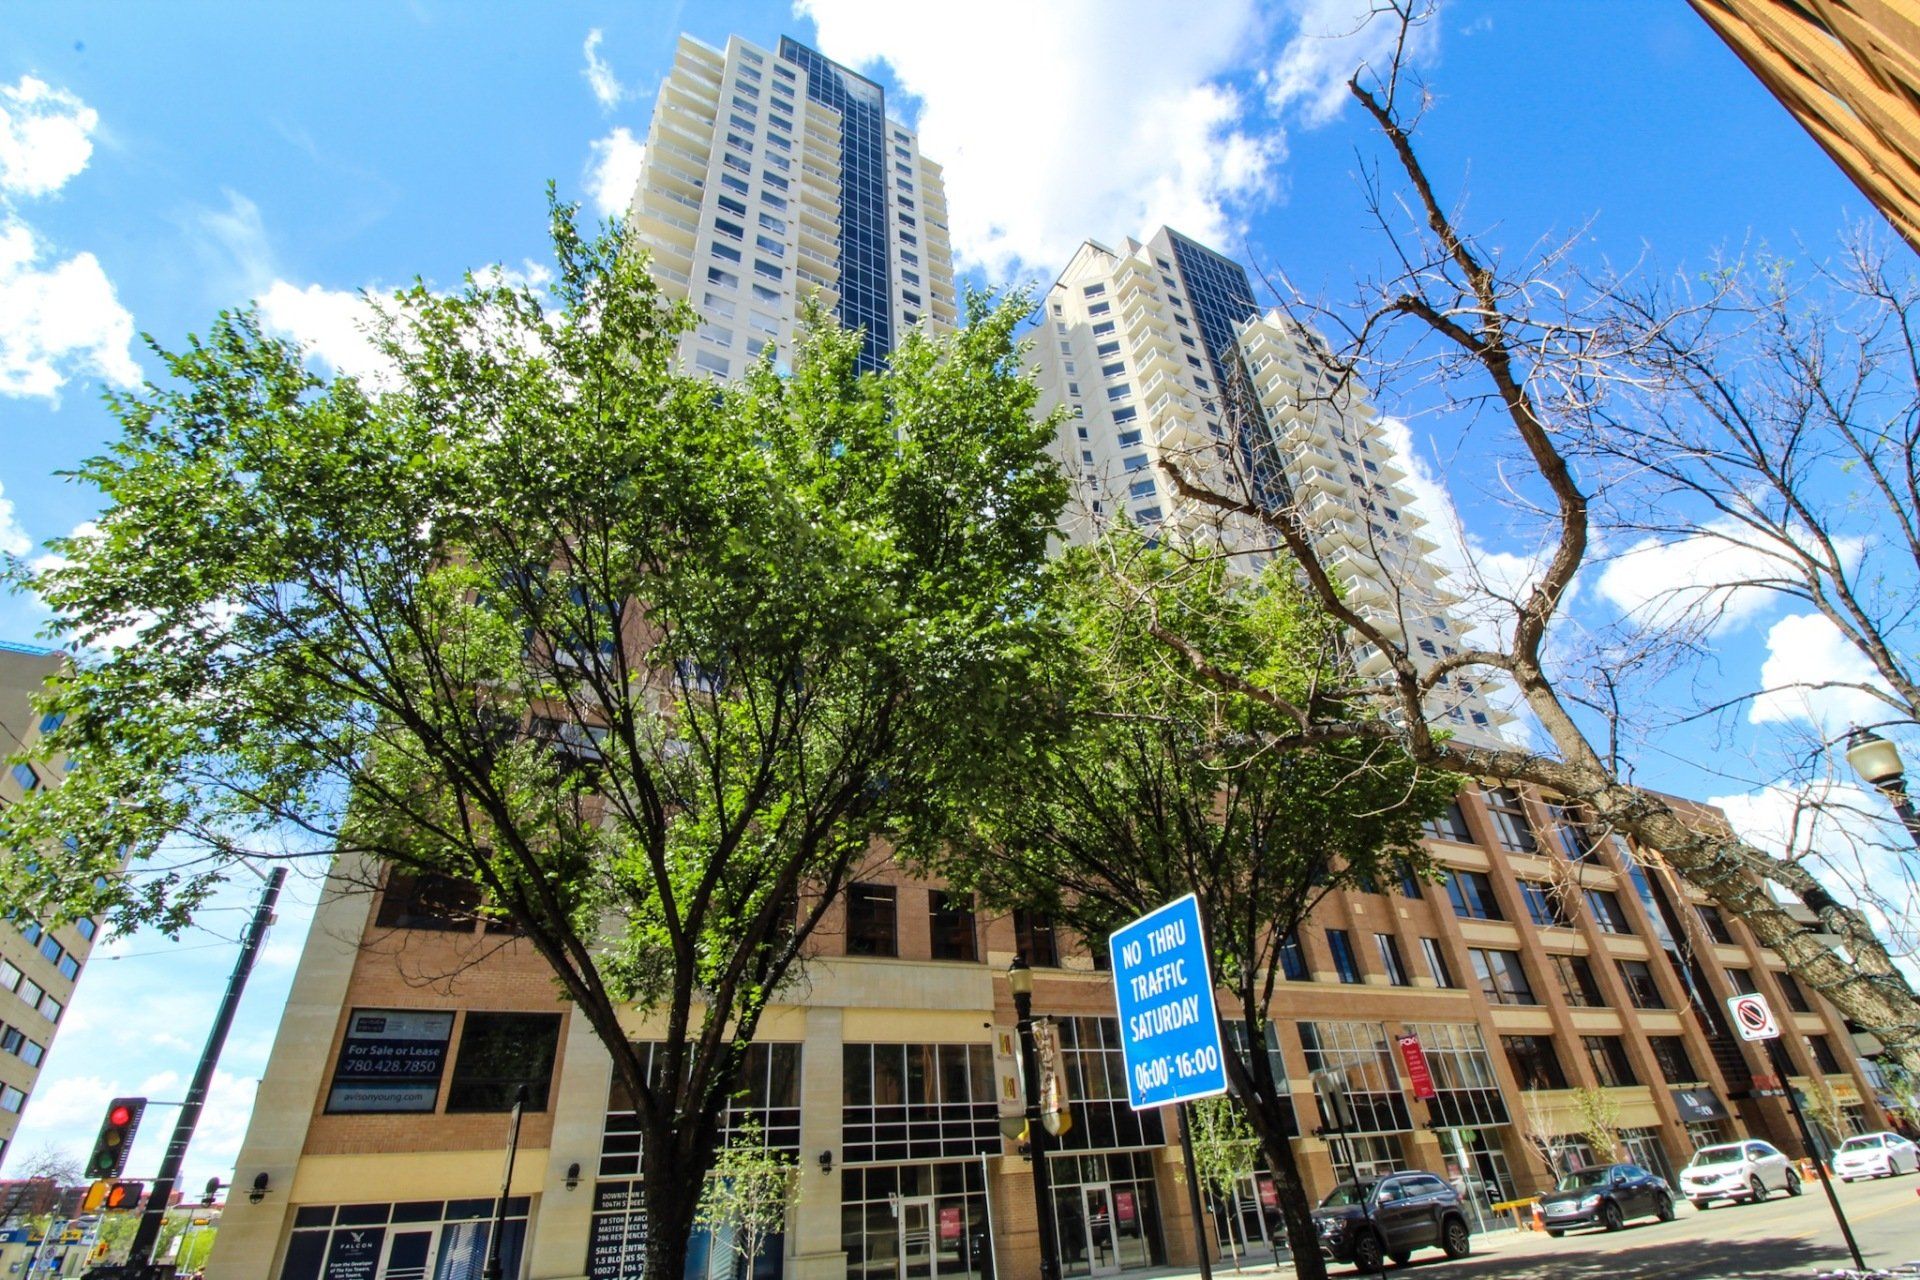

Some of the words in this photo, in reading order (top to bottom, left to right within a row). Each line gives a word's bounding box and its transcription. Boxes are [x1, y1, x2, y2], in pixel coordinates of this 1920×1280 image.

[1122, 940, 1142, 969] NO
[1147, 918, 1186, 957] THRU
[1131, 959, 1188, 1003] TRAFFIC
[1130, 994, 1199, 1043] SATURDAY
[348, 1045, 367, 1055] For
[369, 1045, 393, 1055] Sale
[395, 1046, 407, 1055] or
[410, 1046, 440, 1056] Lease
[346, 1060, 436, 1073] 780.428.7850
[344, 1093, 423, 1102] avisonyoung.com
[622, 1199, 645, 1207] SREET
[609, 1216, 632, 1224] STORY
[598, 1224, 640, 1233] MASTERIECE
[610, 1231, 648, 1240] RESDENCES
[595, 1245, 618, 1255] SALES
[595, 1257, 606, 1265] 1.5
[607, 1254, 635, 1264] BLOKS
[594, 1266, 616, 1275] 10027
